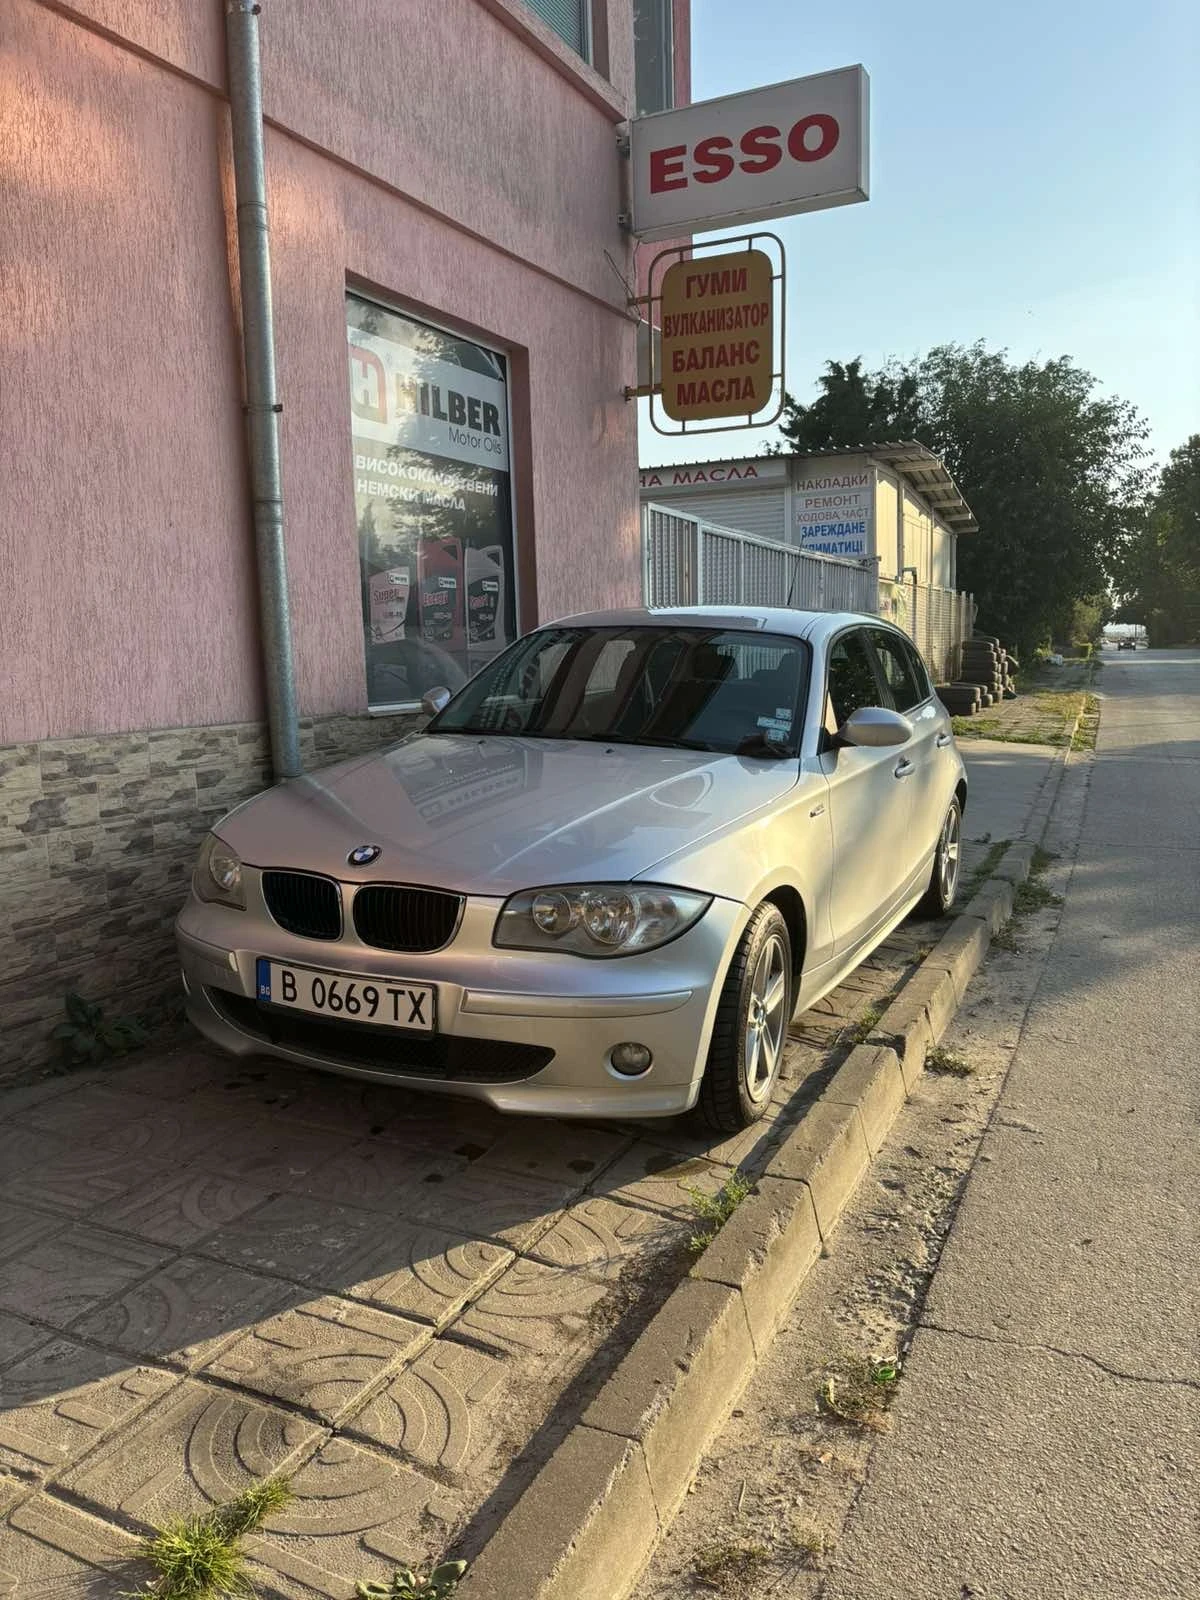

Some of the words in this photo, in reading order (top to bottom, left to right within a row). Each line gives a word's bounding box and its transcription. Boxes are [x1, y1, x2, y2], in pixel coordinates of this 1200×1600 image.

[650, 113, 840, 194] ESSO
[686, 267, 748, 299] ГУМИ
[663, 301, 770, 339] ВУЛКАНИЗАТОР
[672, 339, 761, 373] БАЛАНС
[676, 376, 756, 406] МАСЛА
[449, 428, 481, 449] Motor
[484, 438, 503, 456] Oils
[672, 465, 758, 485] МАСЛА
[796, 474, 869, 492] НАКЛАДКИ
[804, 494, 861, 509] РЕМОНТ
[801, 521, 865, 538] ЗАРЕЖДАНЕ
[260, 985, 271, 996] BG
[281, 970, 298, 1002] B
[311, 977, 380, 1018] 0669
[387, 988, 426, 1025] TX
